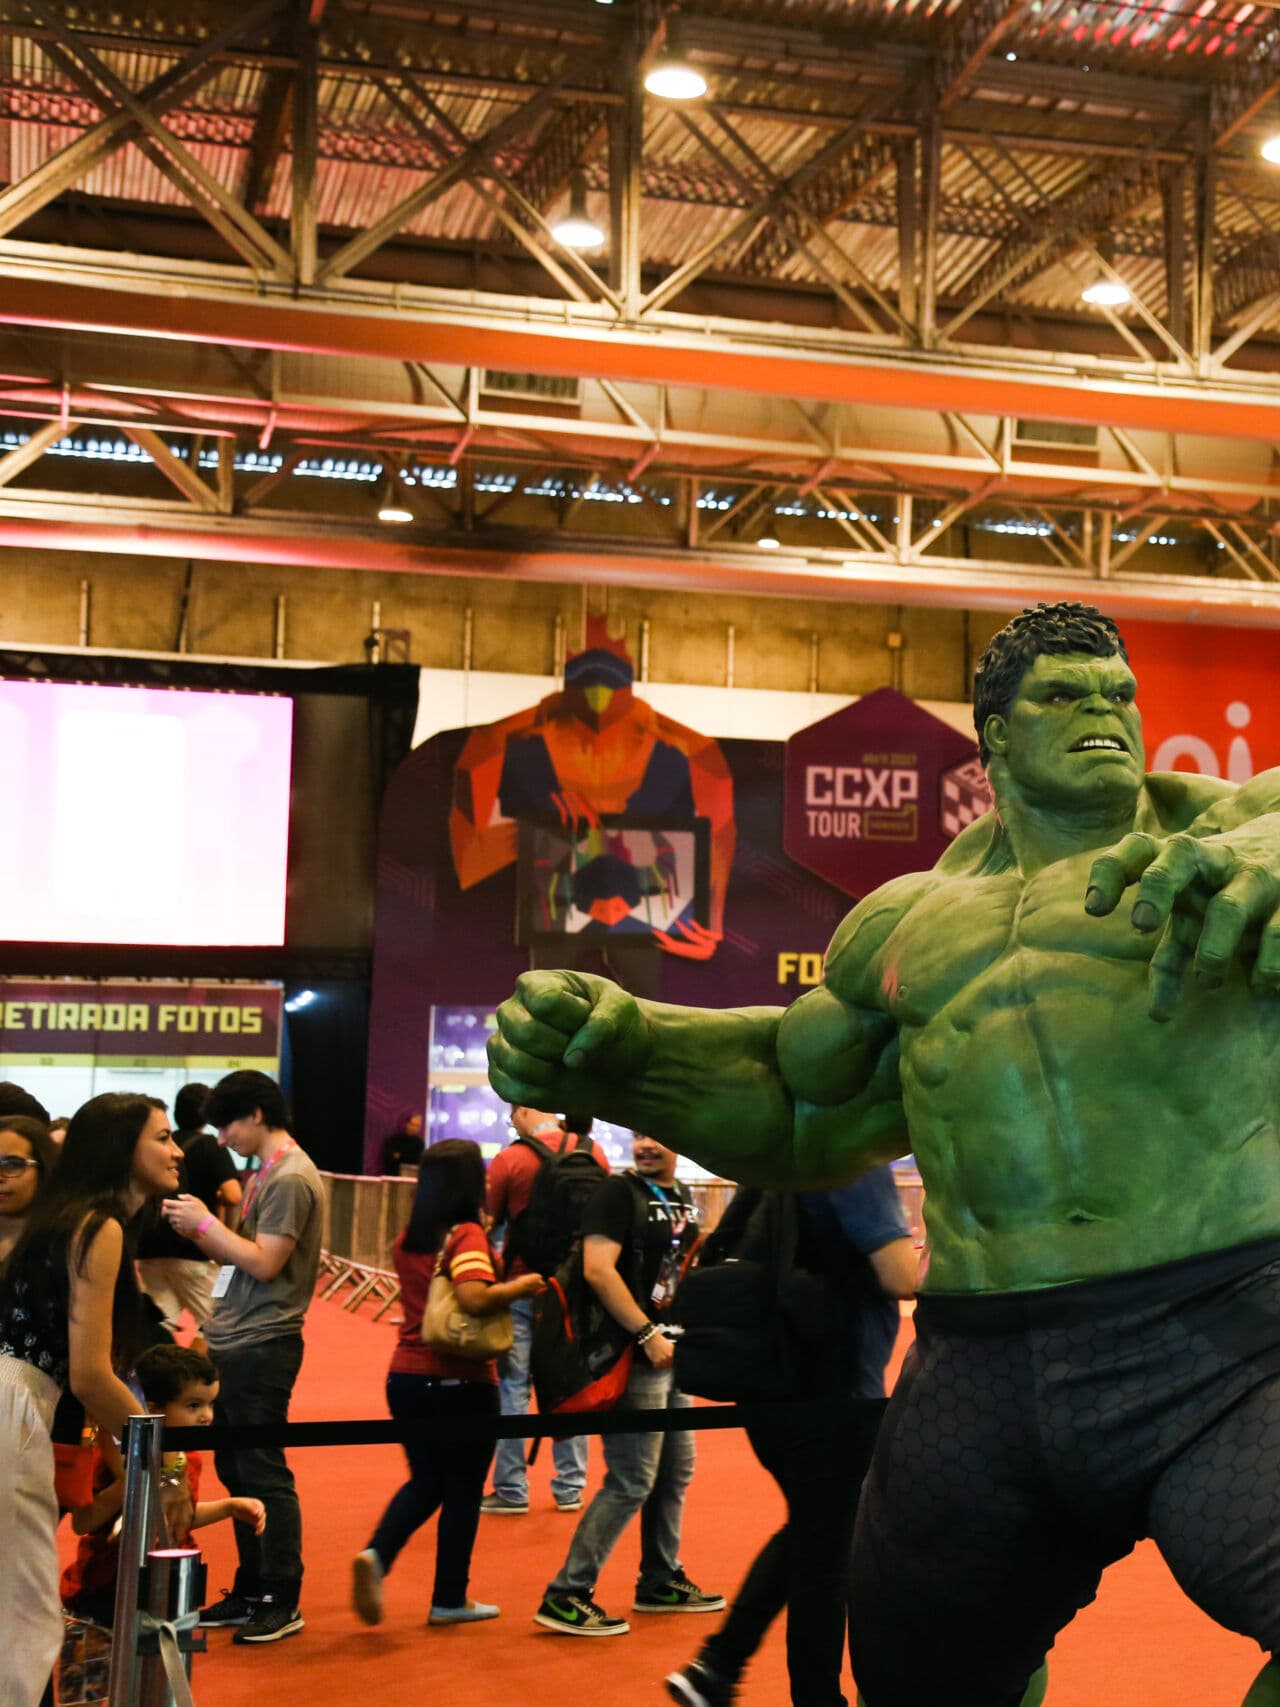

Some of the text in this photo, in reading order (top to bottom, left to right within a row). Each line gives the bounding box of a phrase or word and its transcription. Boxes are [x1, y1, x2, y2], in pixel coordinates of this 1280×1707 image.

[805, 765, 919, 808] CCXP
[806, 810, 862, 838] TOUR
[0, 1001, 262, 1033] ETIRADA FOTOS
